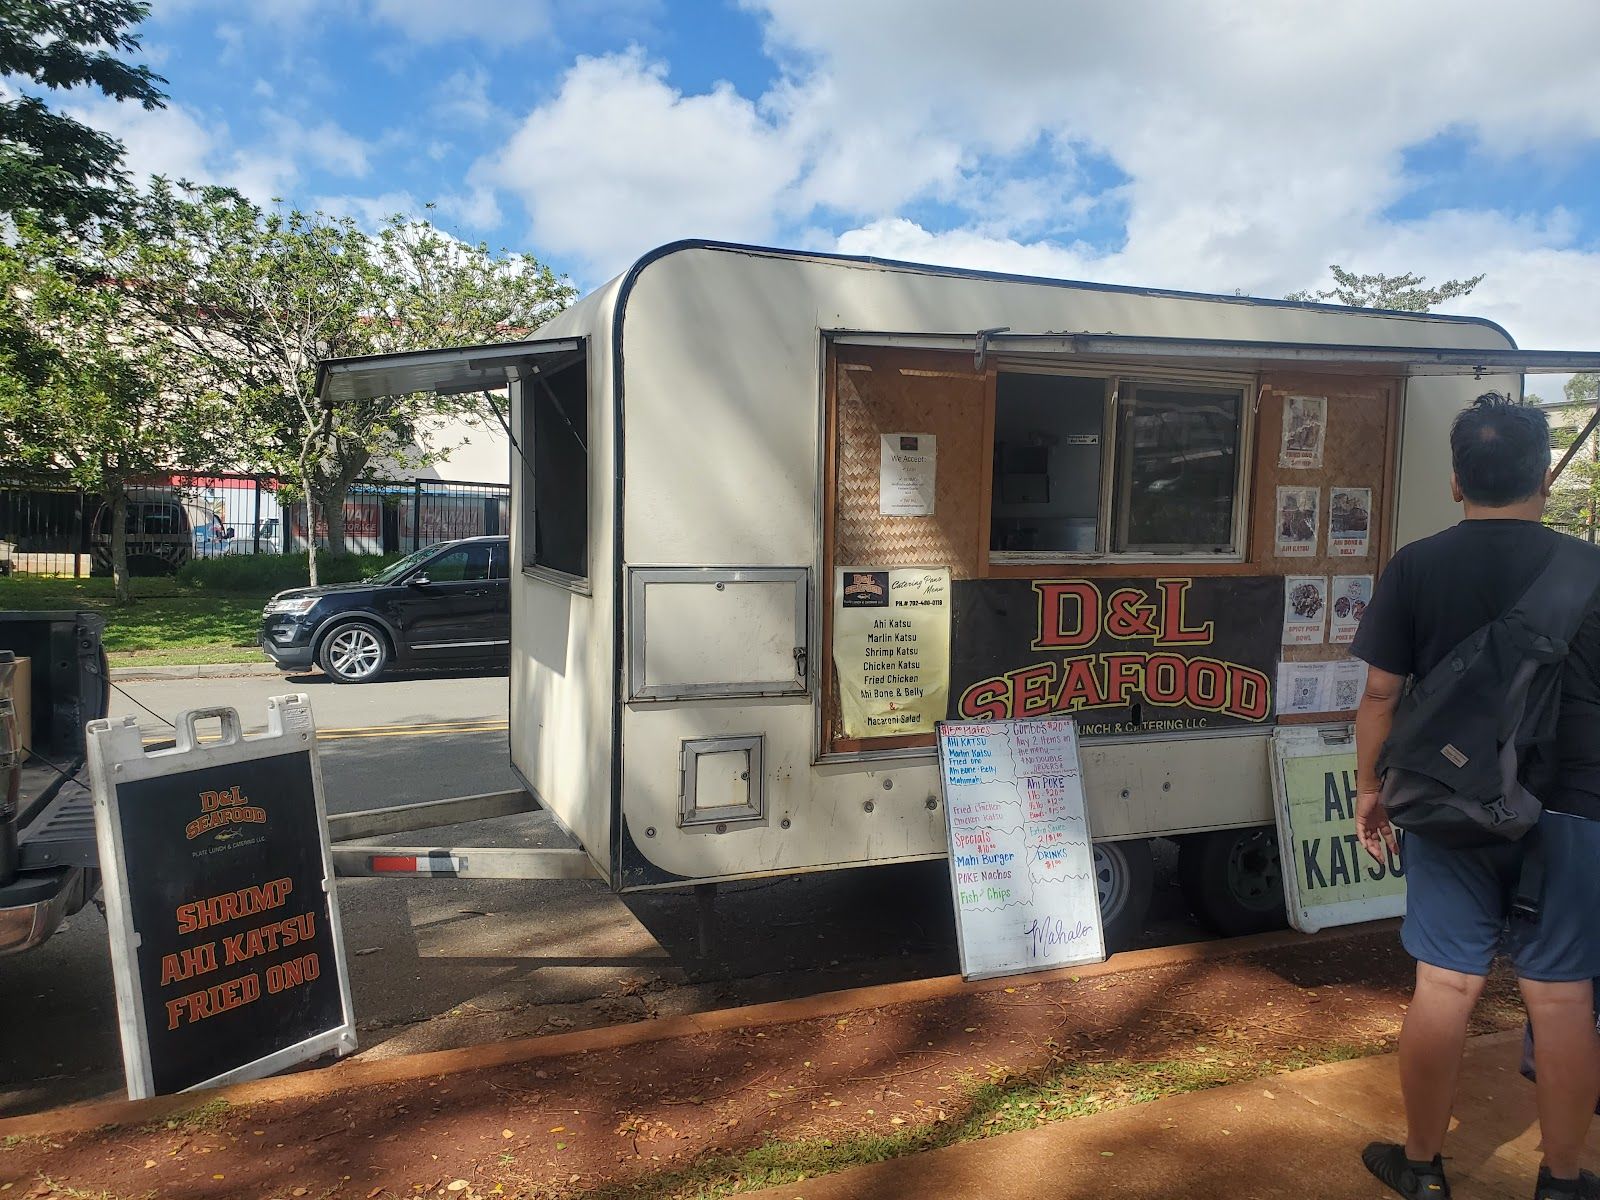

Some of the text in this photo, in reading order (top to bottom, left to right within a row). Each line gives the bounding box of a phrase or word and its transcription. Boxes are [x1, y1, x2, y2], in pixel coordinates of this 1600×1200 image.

[891, 580, 923, 590] Catering
[1031, 577, 1214, 651] D&L
[873, 619, 912, 629] Ahi Katsu
[867, 632, 917, 643] Marlin Katsu
[865, 646, 919, 658] Shrimp Katsu
[863, 660, 920, 671] Chicken Katsu
[864, 674, 919, 685] Fried Chicken
[860, 687, 924, 699] Ahi Bone & Belly
[957, 651, 1271, 723] SEAFOOD
[889, 701, 896, 711] &
[867, 713, 921, 726] Macaroni Salad
[1078, 717, 1207, 735] UNCH & CTERING LLC
[1042, 777, 1065, 789] POKE
[198, 785, 249, 813] D&L
[1324, 769, 1357, 822] AH
[953, 804, 972, 815] Fried
[185, 806, 267, 840] SEAFOOD
[954, 830, 991, 848] Specials
[981, 852, 1015, 866] Burger
[1037, 848, 1068, 860] DRINKS
[957, 869, 1012, 884] POKE Nachos
[960, 890, 979, 904] Fish
[987, 887, 1011, 902] Chips
[176, 876, 293, 935] SHRIMP
[1023, 915, 1093, 958] Mahalo
[160, 911, 316, 987] AHI KATSU
[165, 952, 321, 1031] FRIED ONO
